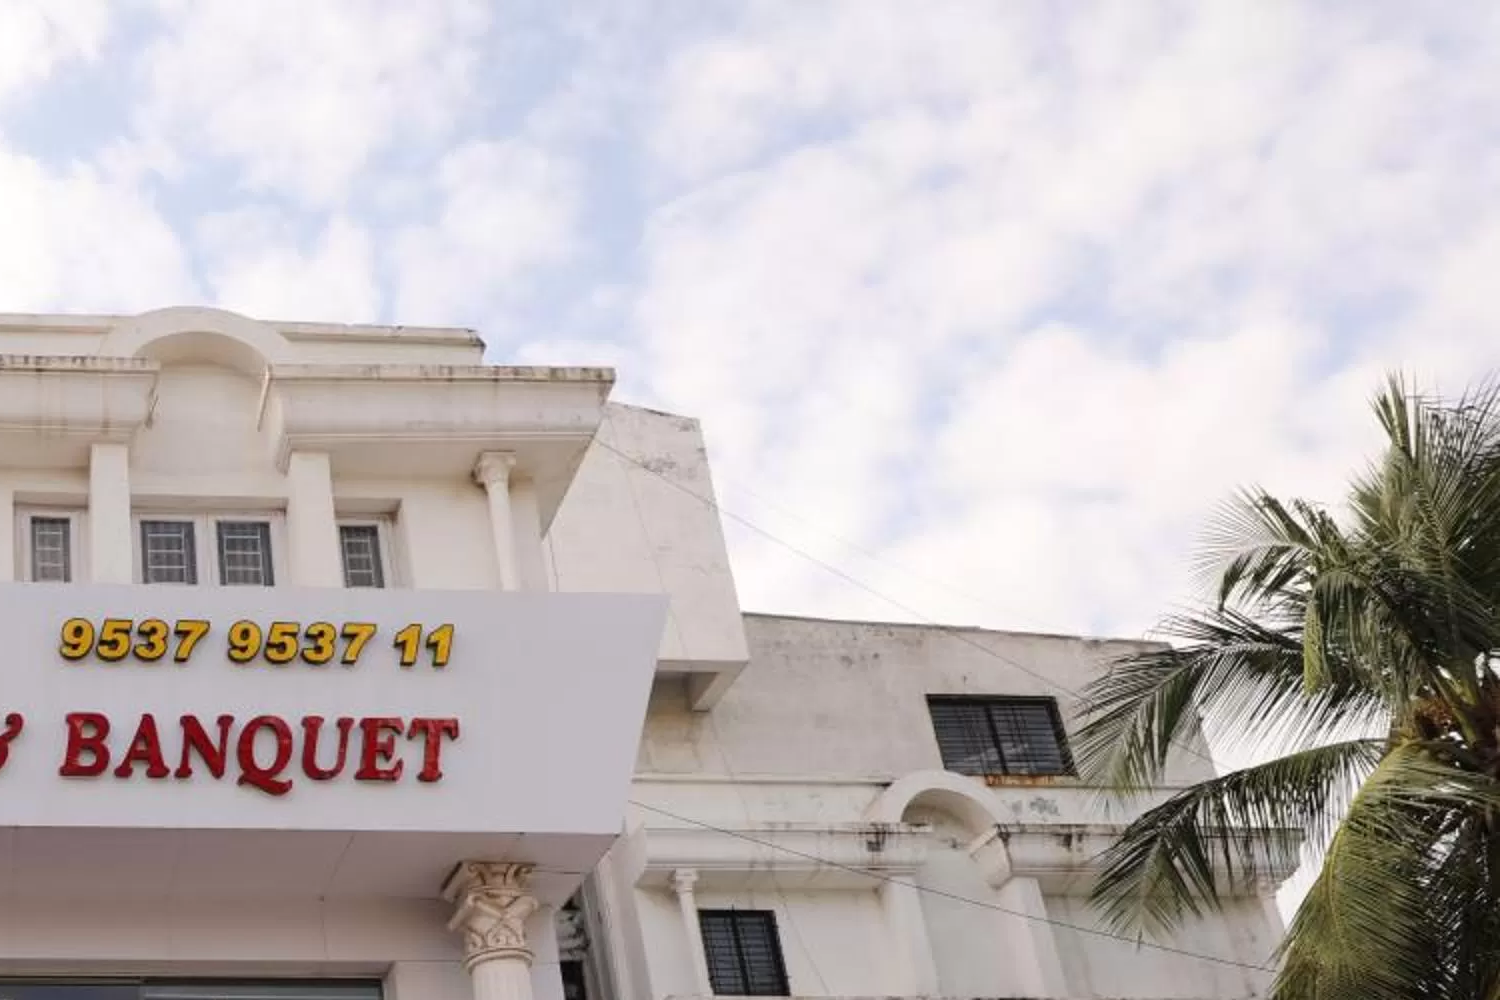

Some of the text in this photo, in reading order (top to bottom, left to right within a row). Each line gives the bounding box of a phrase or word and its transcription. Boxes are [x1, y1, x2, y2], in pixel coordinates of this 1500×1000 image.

[59, 617, 456, 666] 9537 9537 11
[58, 712, 461, 796] BANQUET
